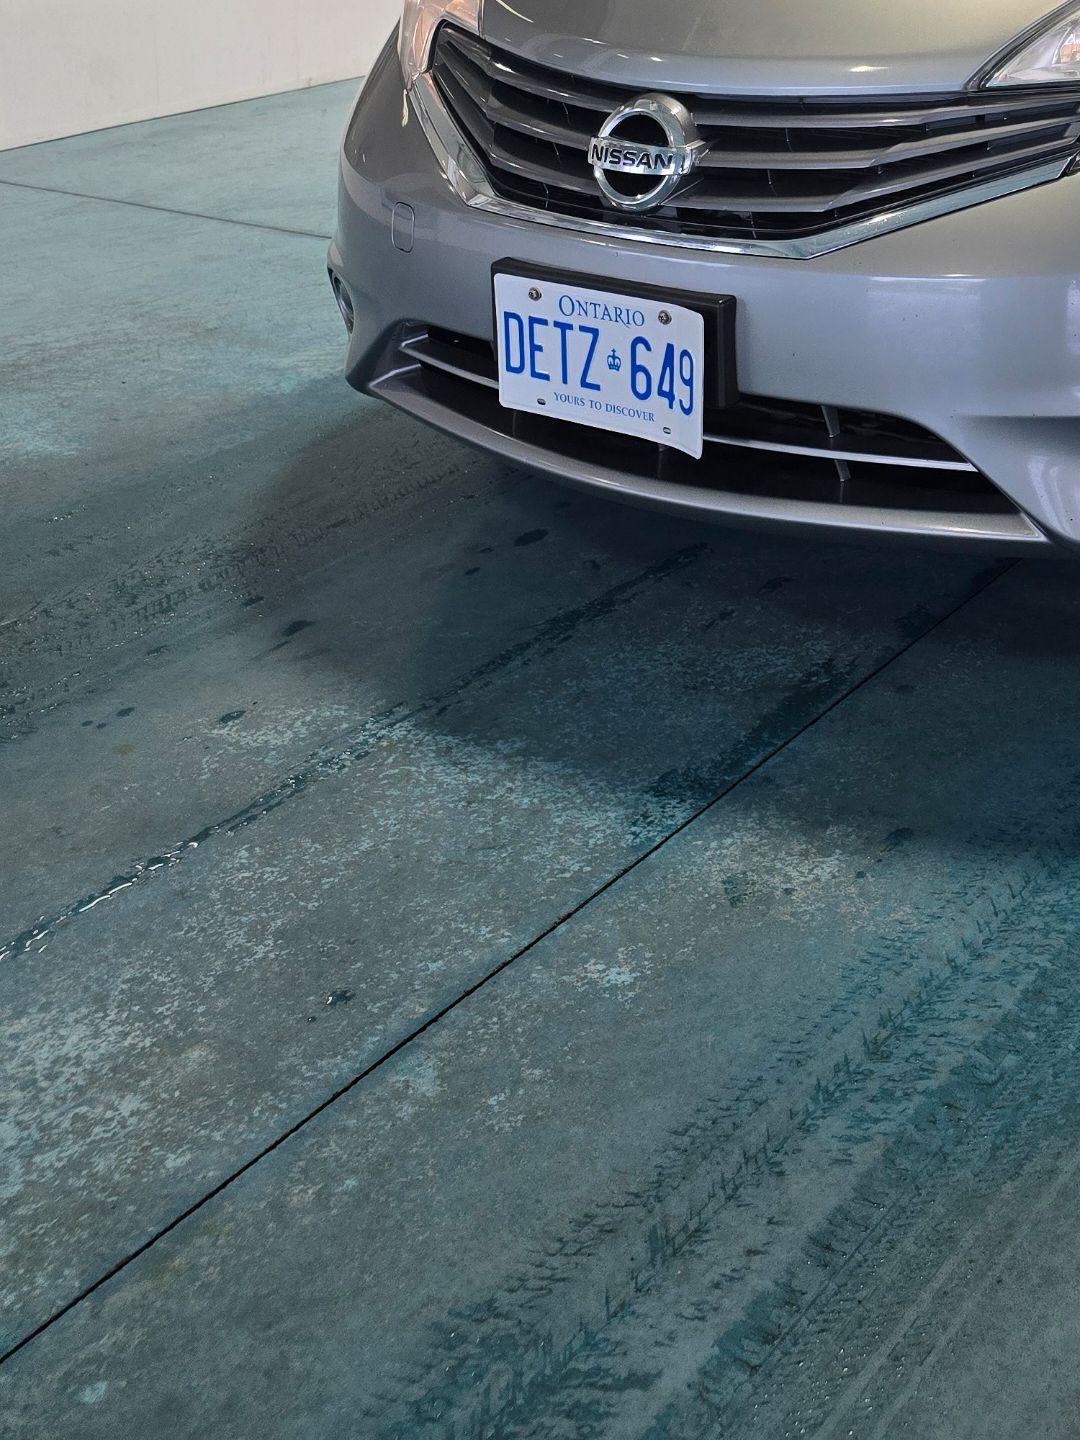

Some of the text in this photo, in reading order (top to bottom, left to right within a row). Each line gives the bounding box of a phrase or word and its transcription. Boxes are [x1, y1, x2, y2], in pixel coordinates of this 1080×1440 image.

[591, 144, 674, 170] NISSAN
[558, 295, 645, 328] ONTARIO
[503, 311, 694, 416] DETZ 649
[554, 392, 655, 423] YOURS TO DISCOVER
